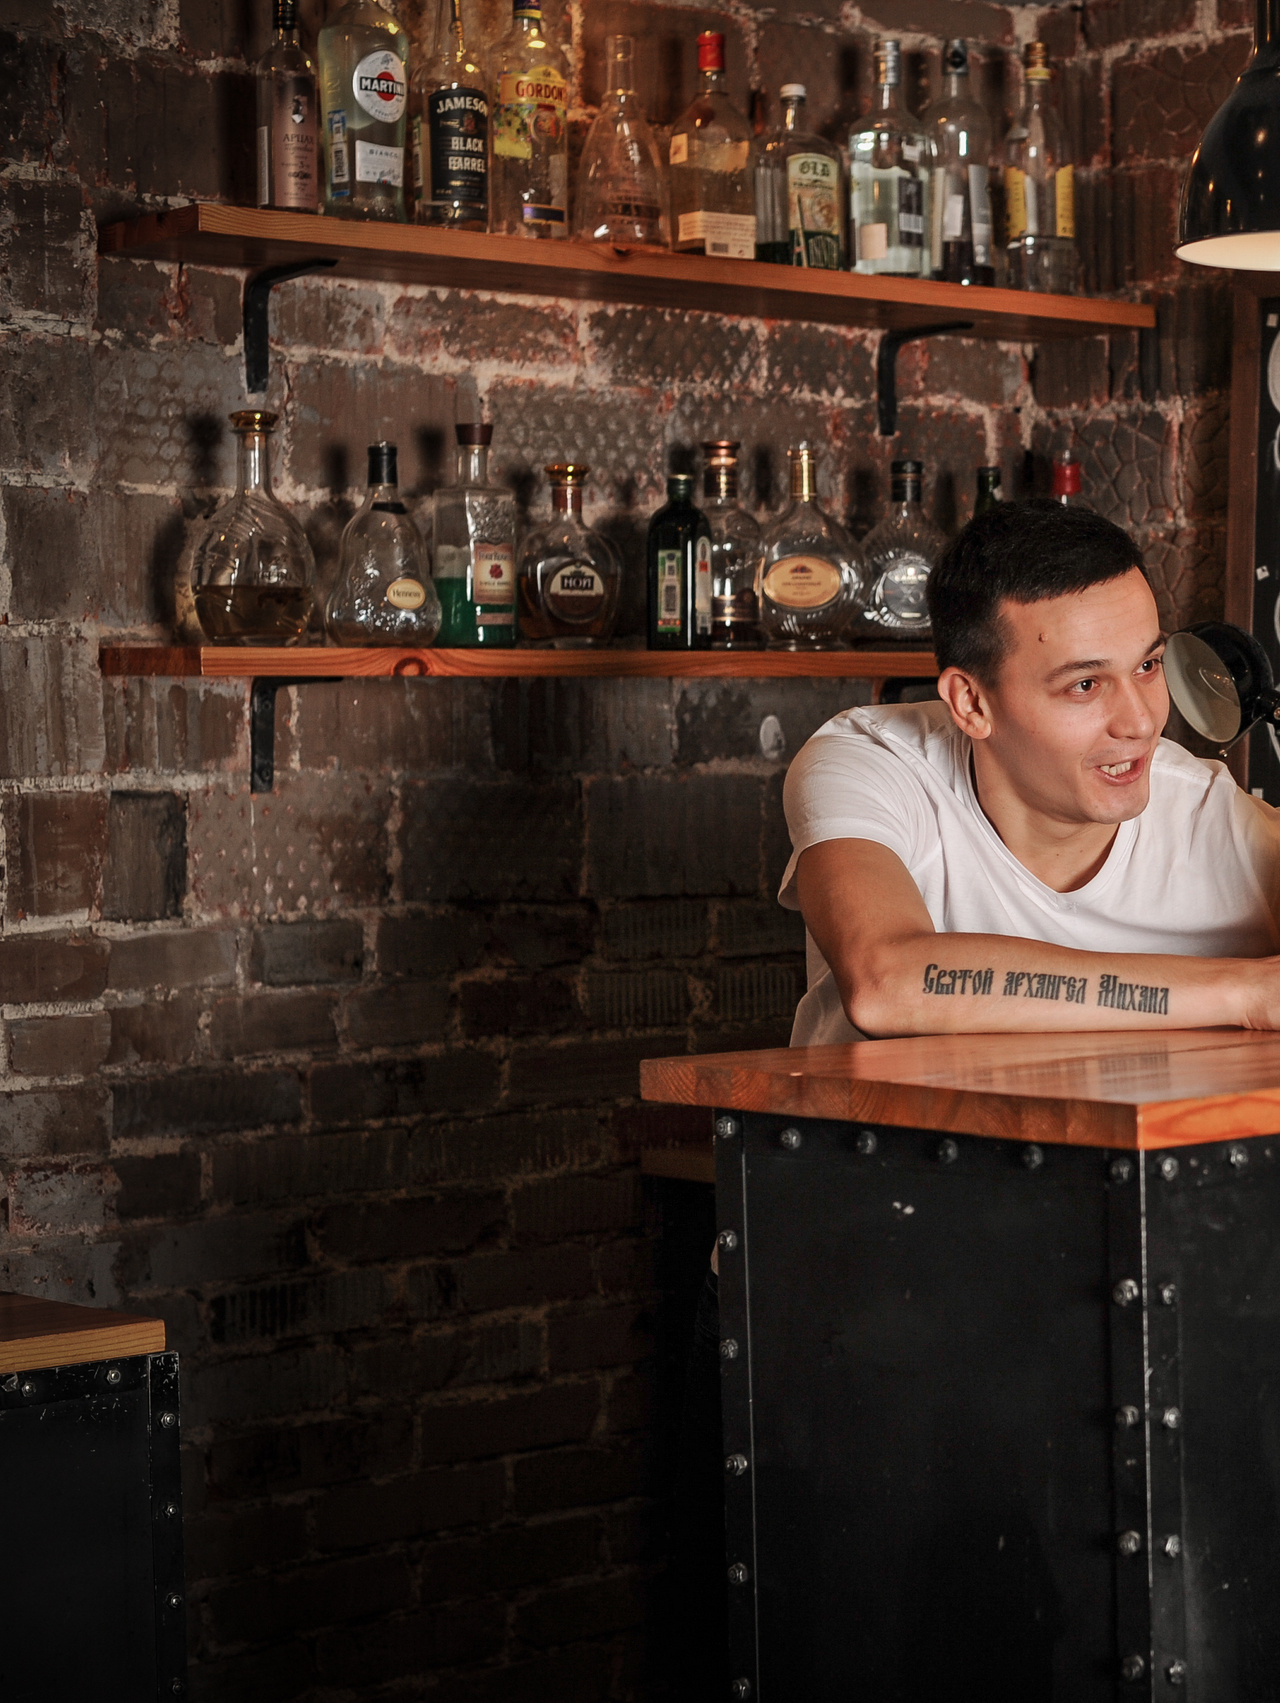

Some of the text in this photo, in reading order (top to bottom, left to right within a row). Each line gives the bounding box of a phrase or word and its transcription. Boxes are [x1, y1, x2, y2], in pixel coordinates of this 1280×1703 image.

[451, 136, 484, 153] BLACK
[922, 963, 1170, 1016] Святой архангел Михаил
